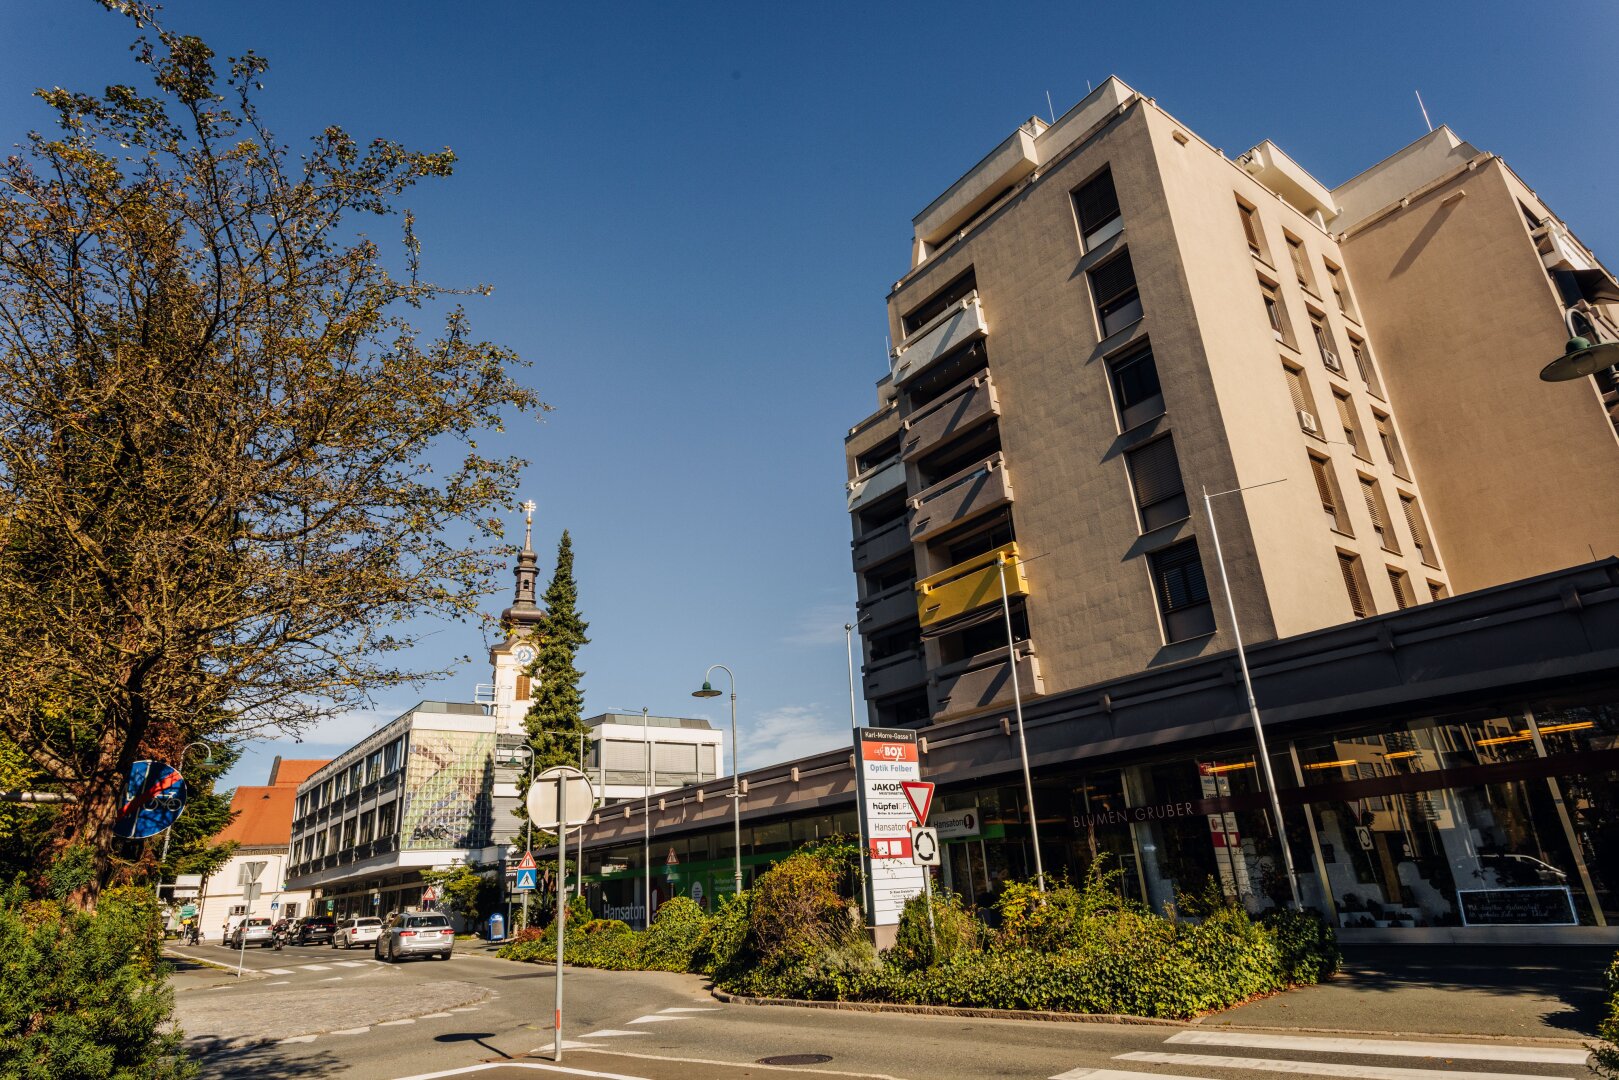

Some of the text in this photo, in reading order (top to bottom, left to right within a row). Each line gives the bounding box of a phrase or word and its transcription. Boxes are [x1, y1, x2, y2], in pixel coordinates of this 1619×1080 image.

[870, 764, 913, 773] Optik Felber
[1073, 802, 1194, 828] BLUMEN GRUBER
[874, 822, 907, 831] Hansaton
[934, 818, 965, 829] Hansaton
[603, 902, 645, 920] Hansaton
